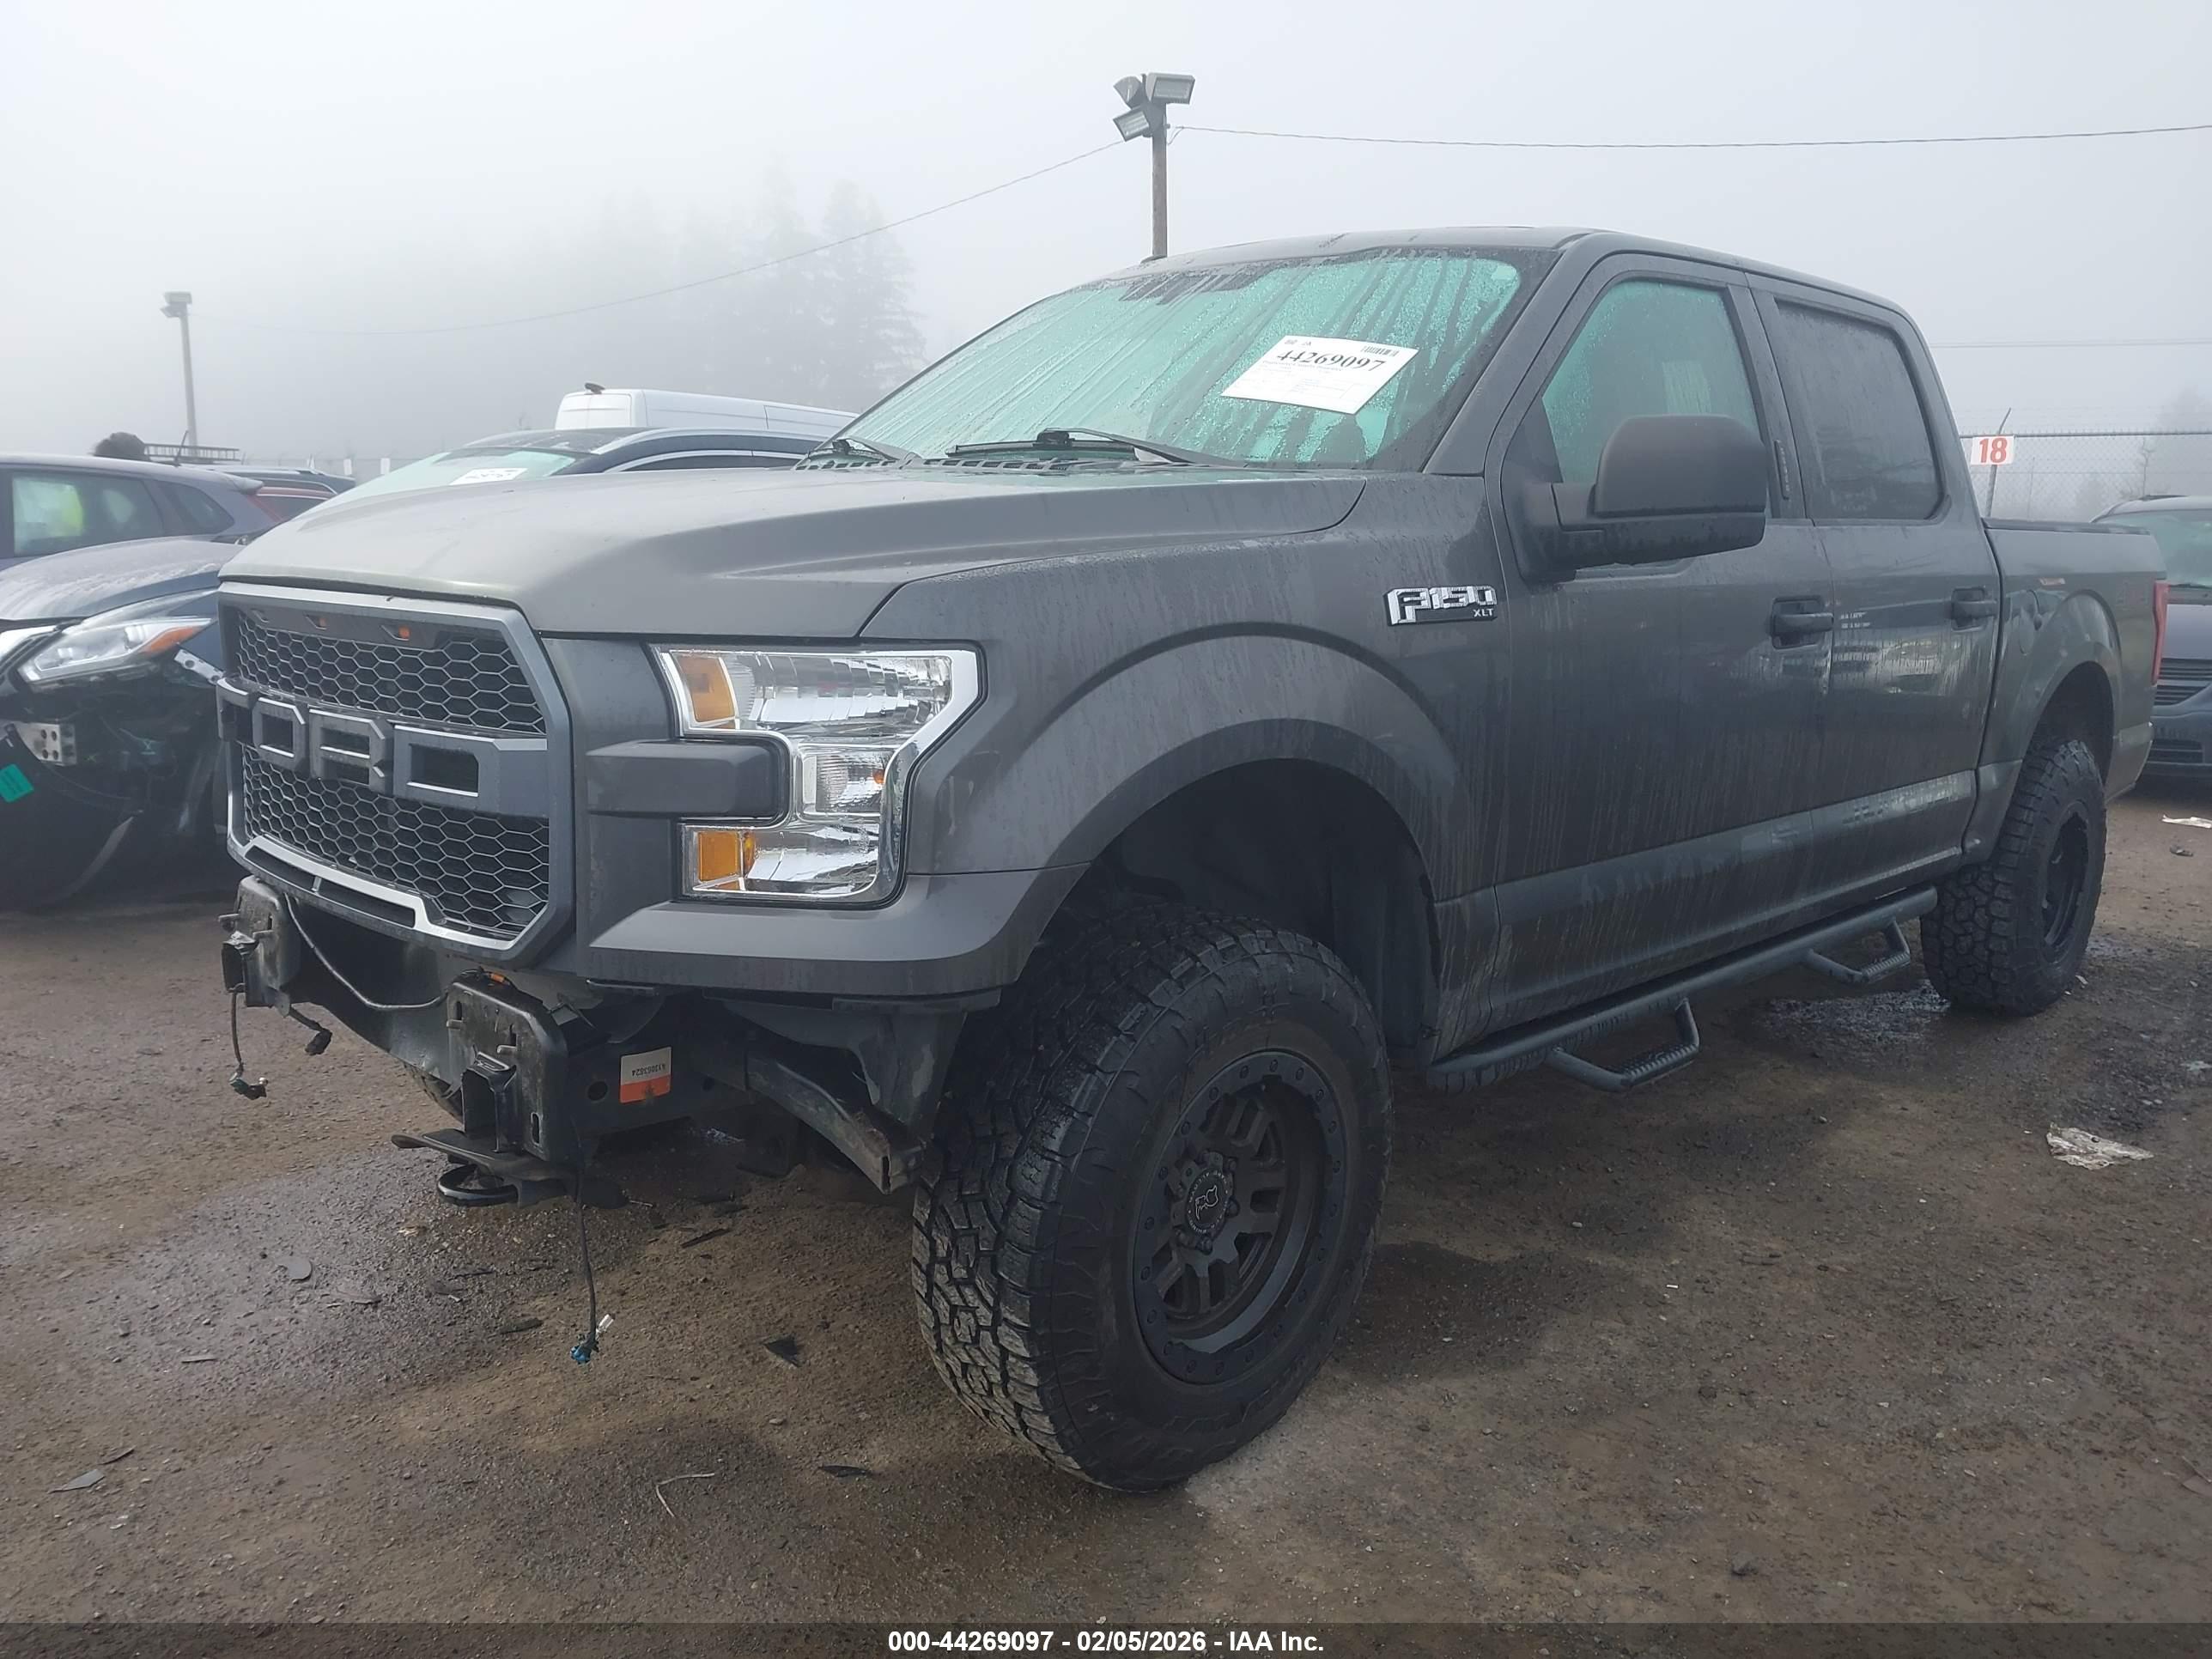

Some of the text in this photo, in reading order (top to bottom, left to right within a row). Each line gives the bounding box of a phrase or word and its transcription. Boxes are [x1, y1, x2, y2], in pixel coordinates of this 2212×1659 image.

[1276, 349, 1387, 372] 44269097
[1978, 437, 2008, 464] 18
[1473, 608, 1494, 617] XLT
[217, 677, 498, 812] FORD
